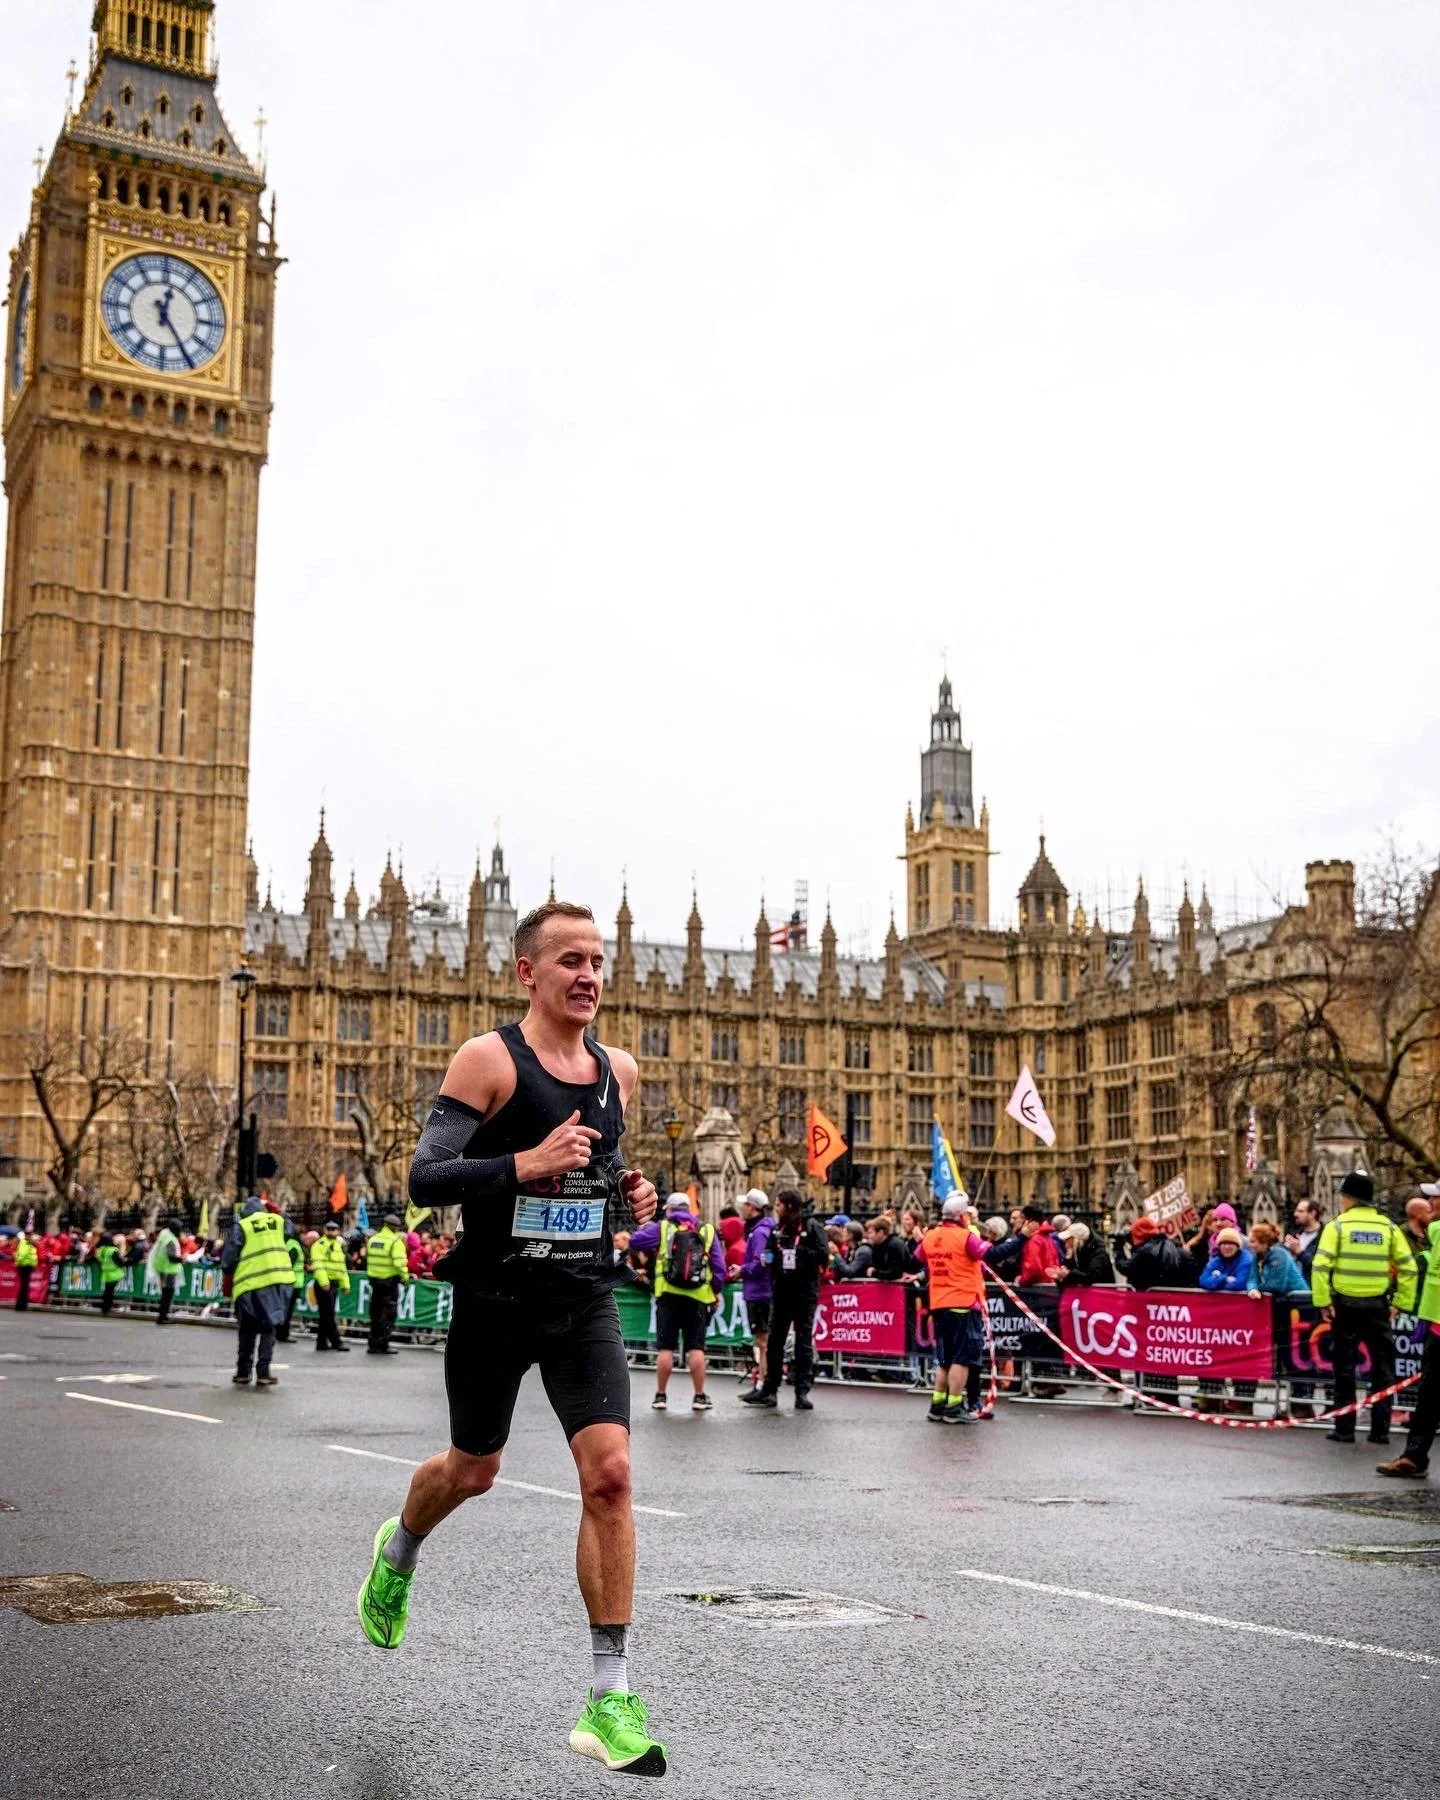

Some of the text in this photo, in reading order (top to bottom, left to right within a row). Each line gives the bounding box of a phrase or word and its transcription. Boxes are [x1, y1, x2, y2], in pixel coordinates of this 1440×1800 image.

[563, 1187, 592, 1195] SERVICES
[1162, 1177, 1186, 1203] ZERO
[540, 1206, 590, 1232] 1499
[1177, 1207, 1198, 1230] LATE
[551, 1252, 568, 1260] new
[568, 1250, 594, 1260] balance
[832, 1294, 859, 1307] TATA
[831, 1310, 895, 1326] CONSULTANCY
[1071, 1298, 1192, 1358] tcs TATA
[831, 1328, 872, 1343] SERVICES
[1146, 1325, 1254, 1346] CONSULTANCY
[1146, 1346, 1213, 1366] SERVICES
